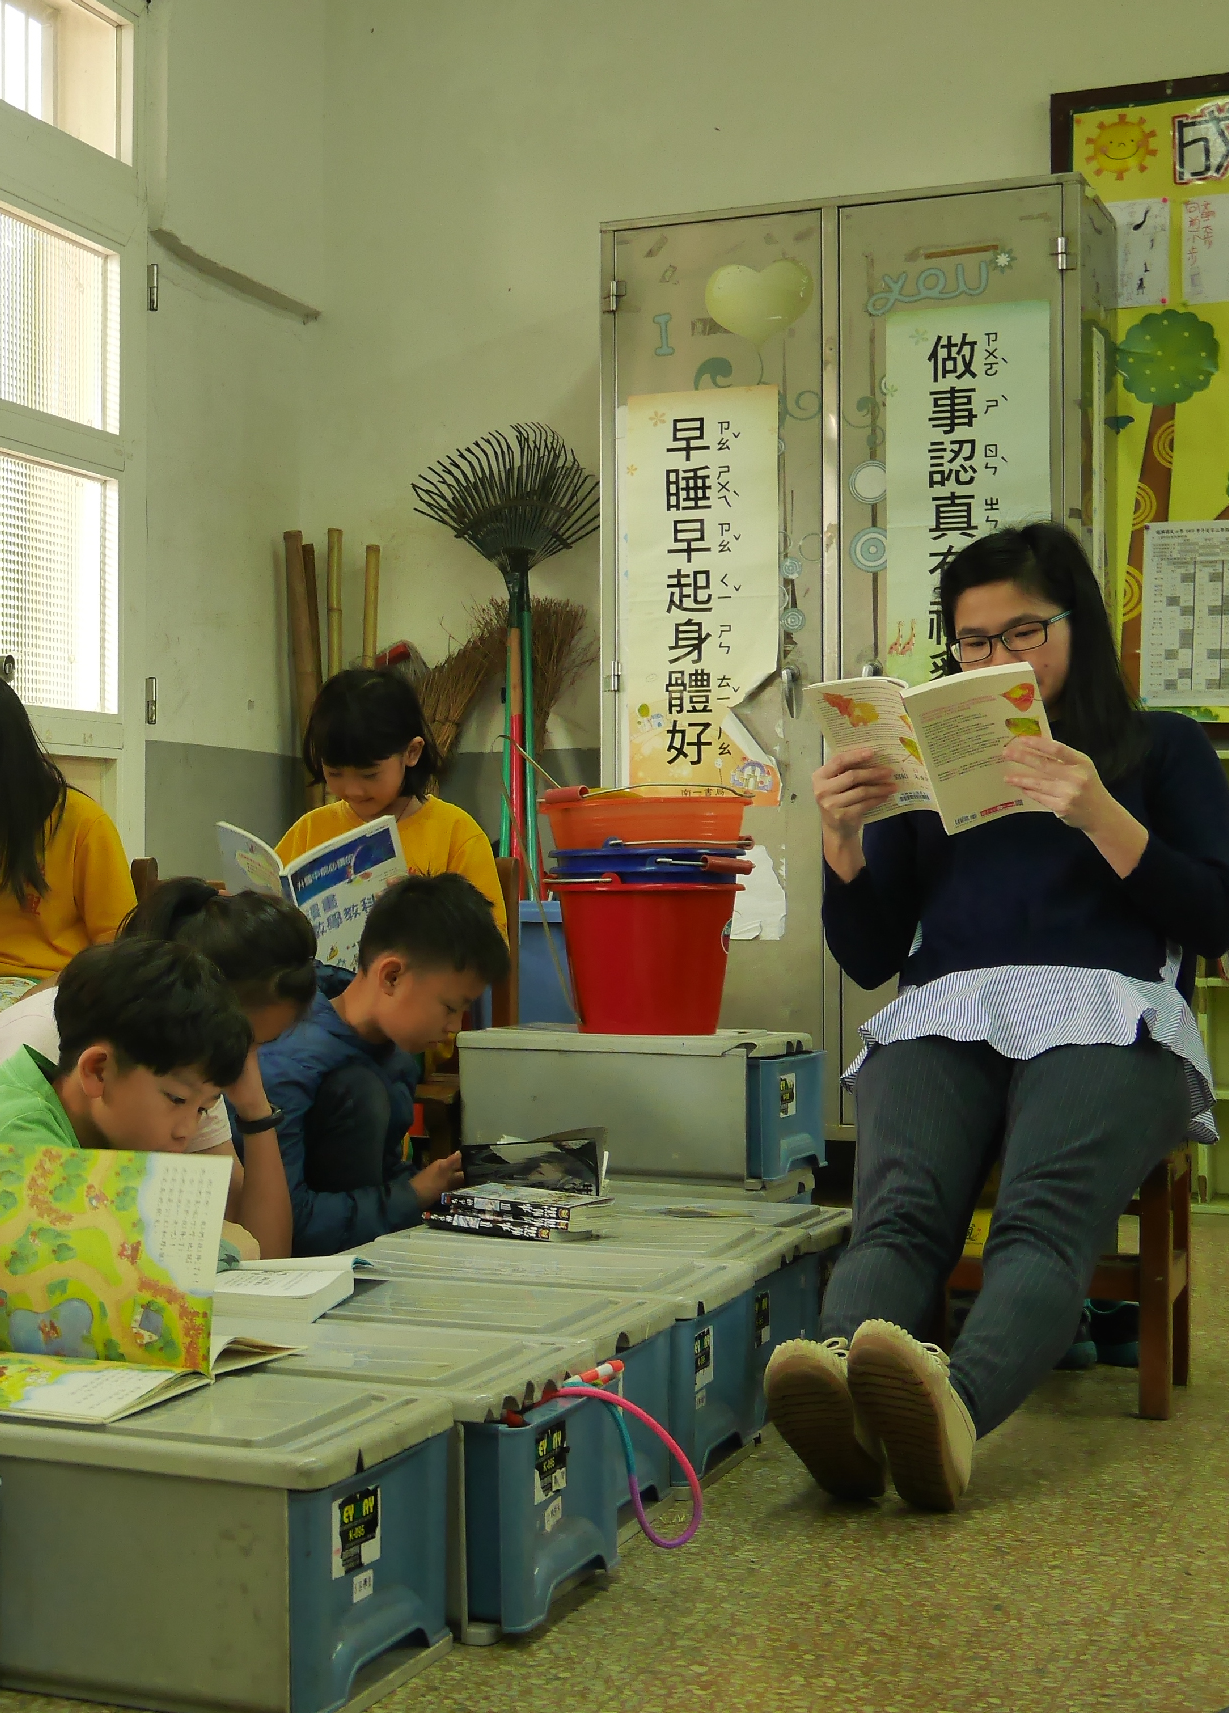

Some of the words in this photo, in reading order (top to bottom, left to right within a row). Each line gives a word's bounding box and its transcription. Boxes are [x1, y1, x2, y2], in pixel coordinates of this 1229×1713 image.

[665, 417, 713, 766] 早睡早起身體好
